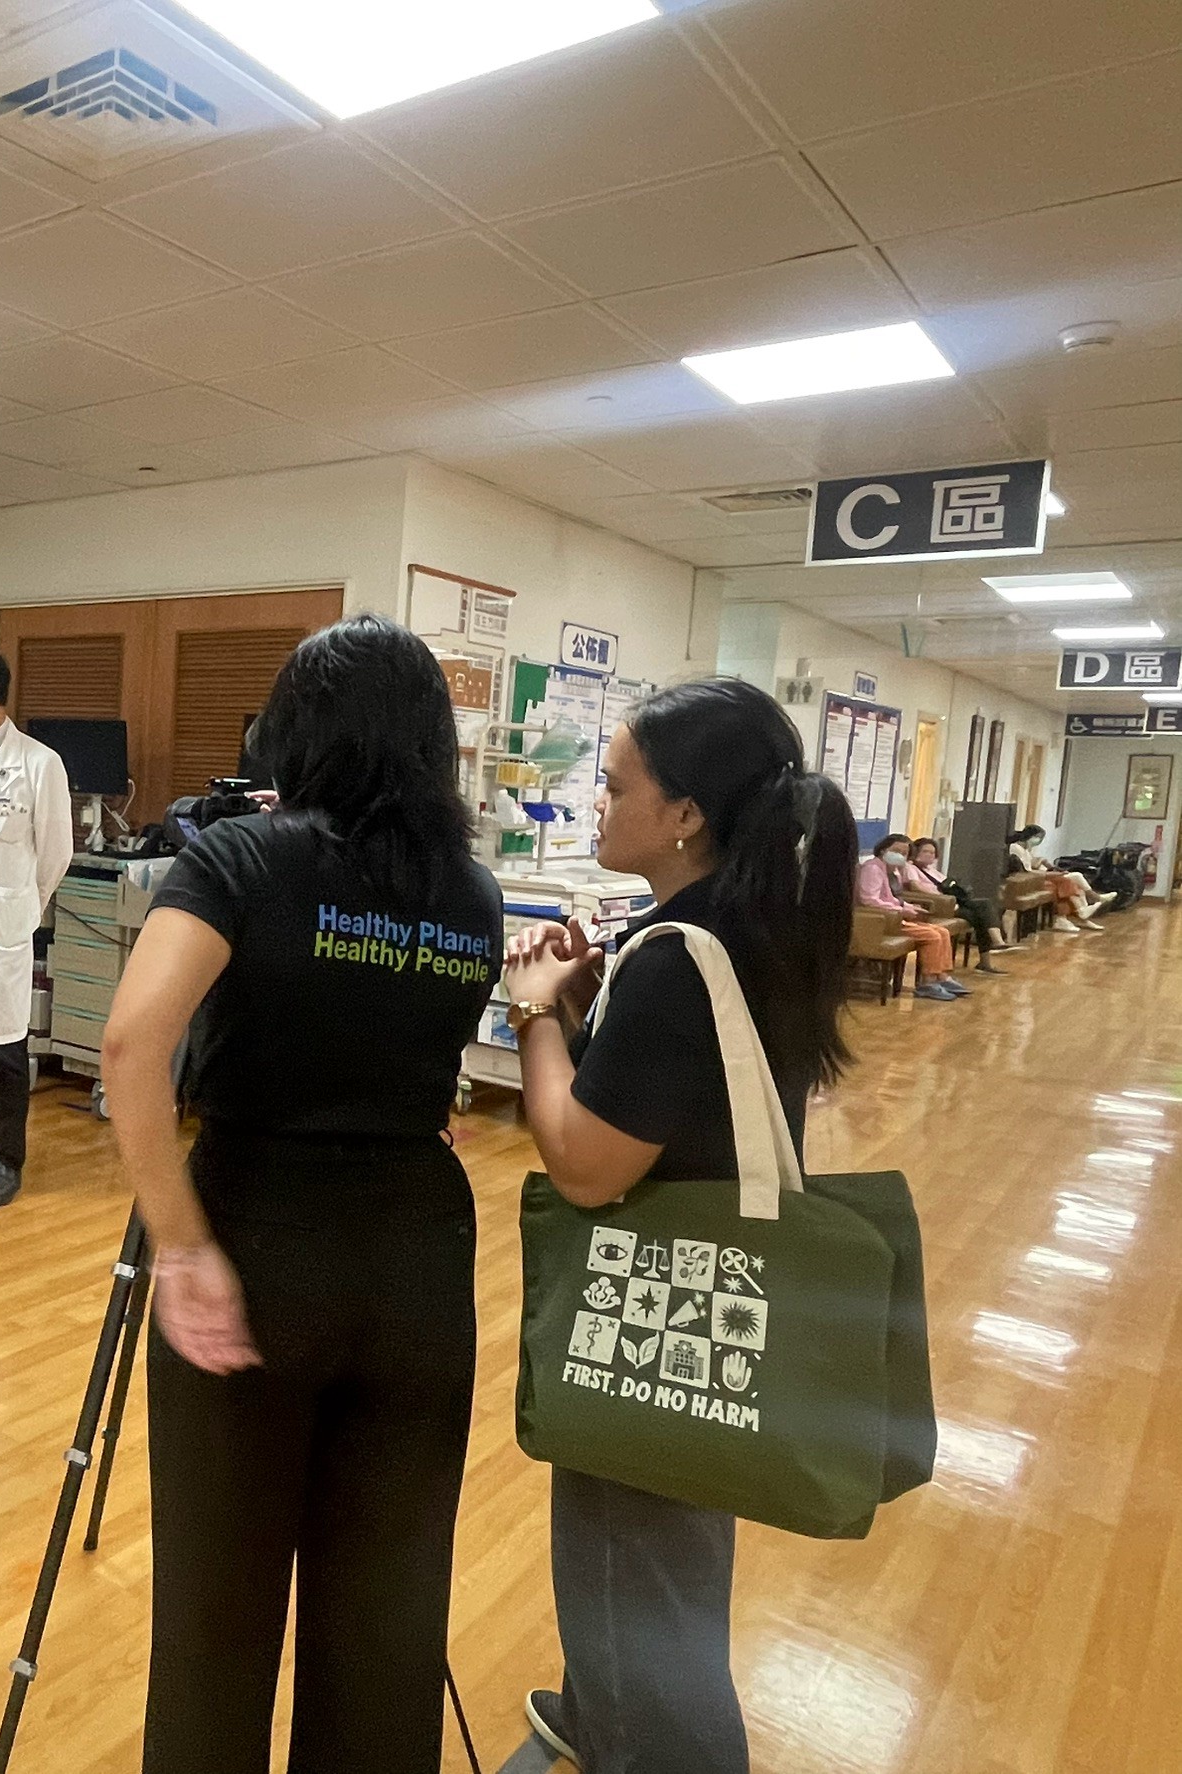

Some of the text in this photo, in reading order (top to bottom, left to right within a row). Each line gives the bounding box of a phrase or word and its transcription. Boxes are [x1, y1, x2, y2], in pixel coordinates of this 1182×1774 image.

[836, 474, 1010, 550] C 區
[1074, 651, 1167, 683] D 區
[1156, 709, 1178, 730] E
[318, 904, 491, 957] Healthy Planet
[314, 931, 489, 984] Healthy People
[562, 1361, 760, 1432] FIRST, DO NO HARM
